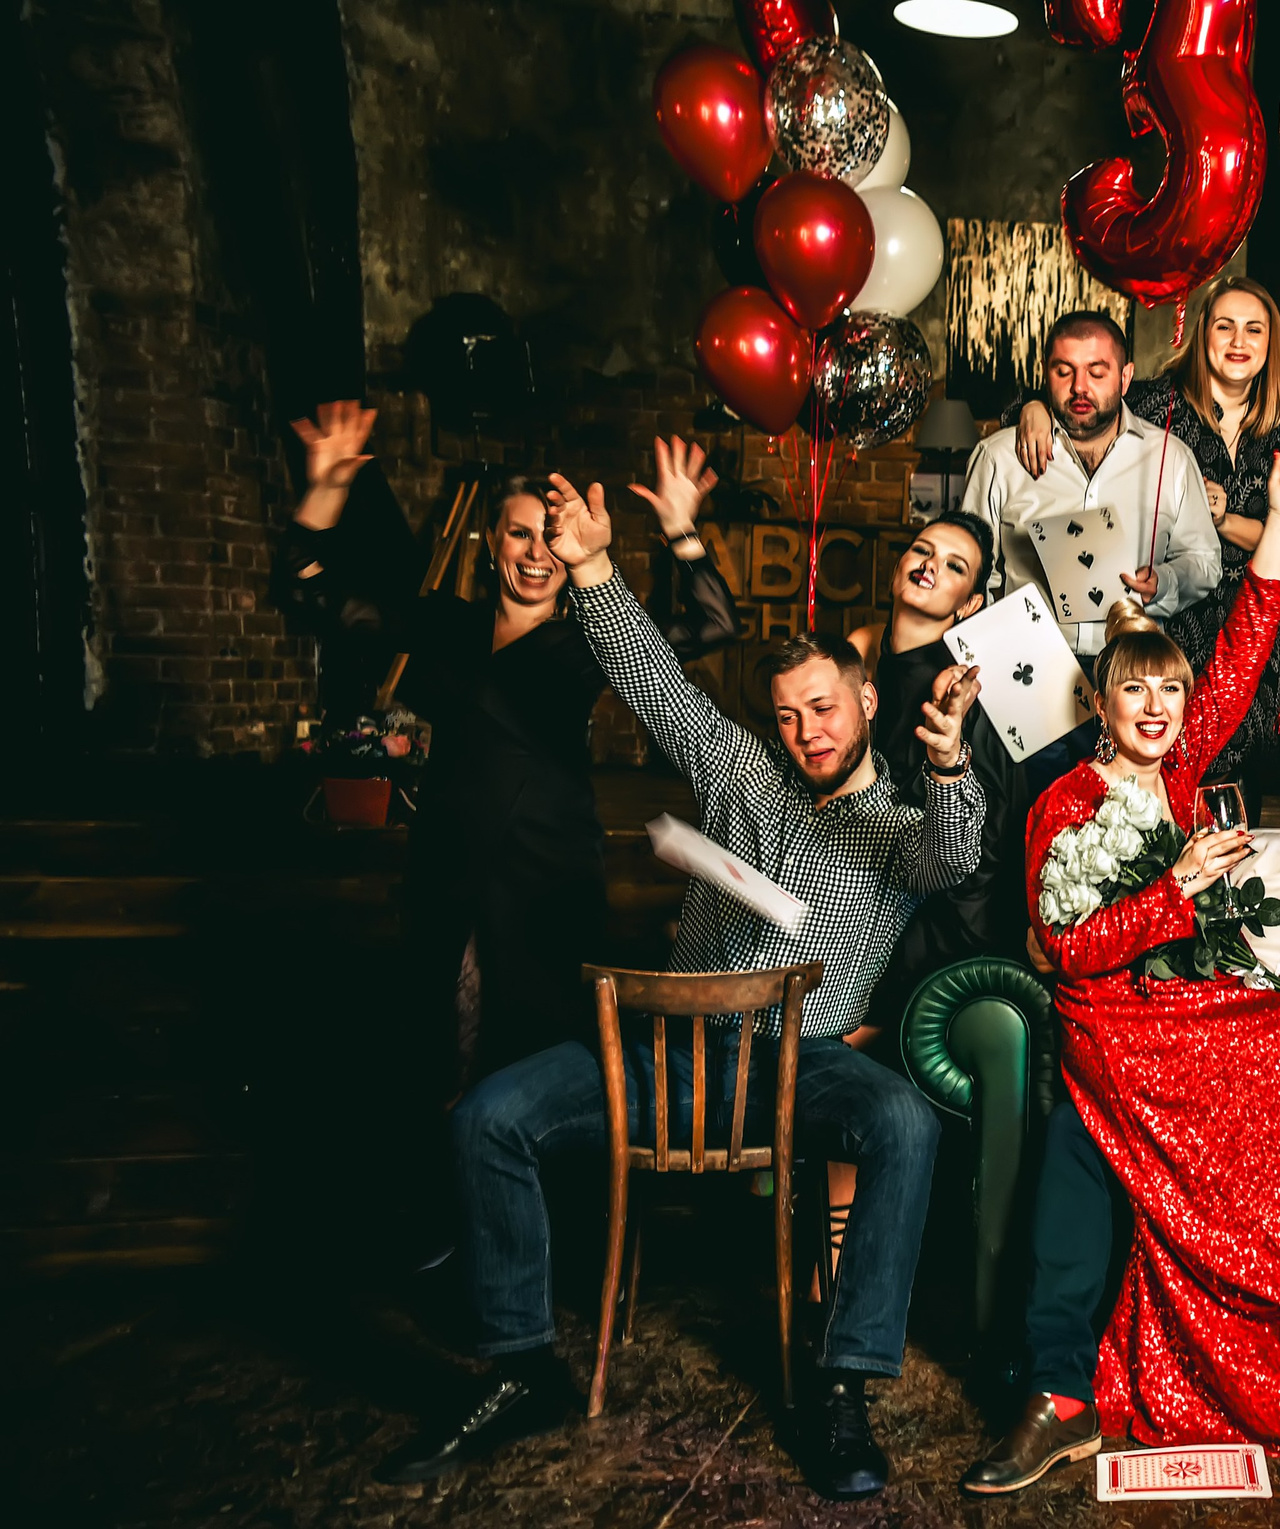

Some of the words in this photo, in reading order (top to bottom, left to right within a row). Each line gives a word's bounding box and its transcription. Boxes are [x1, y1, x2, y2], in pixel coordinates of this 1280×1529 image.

[1024, 597, 1036, 613] A
[1061, 603, 1072, 617] 3
[957, 636, 969, 653] A
[1079, 695, 1091, 712] A
[1012, 736, 1025, 751] A
